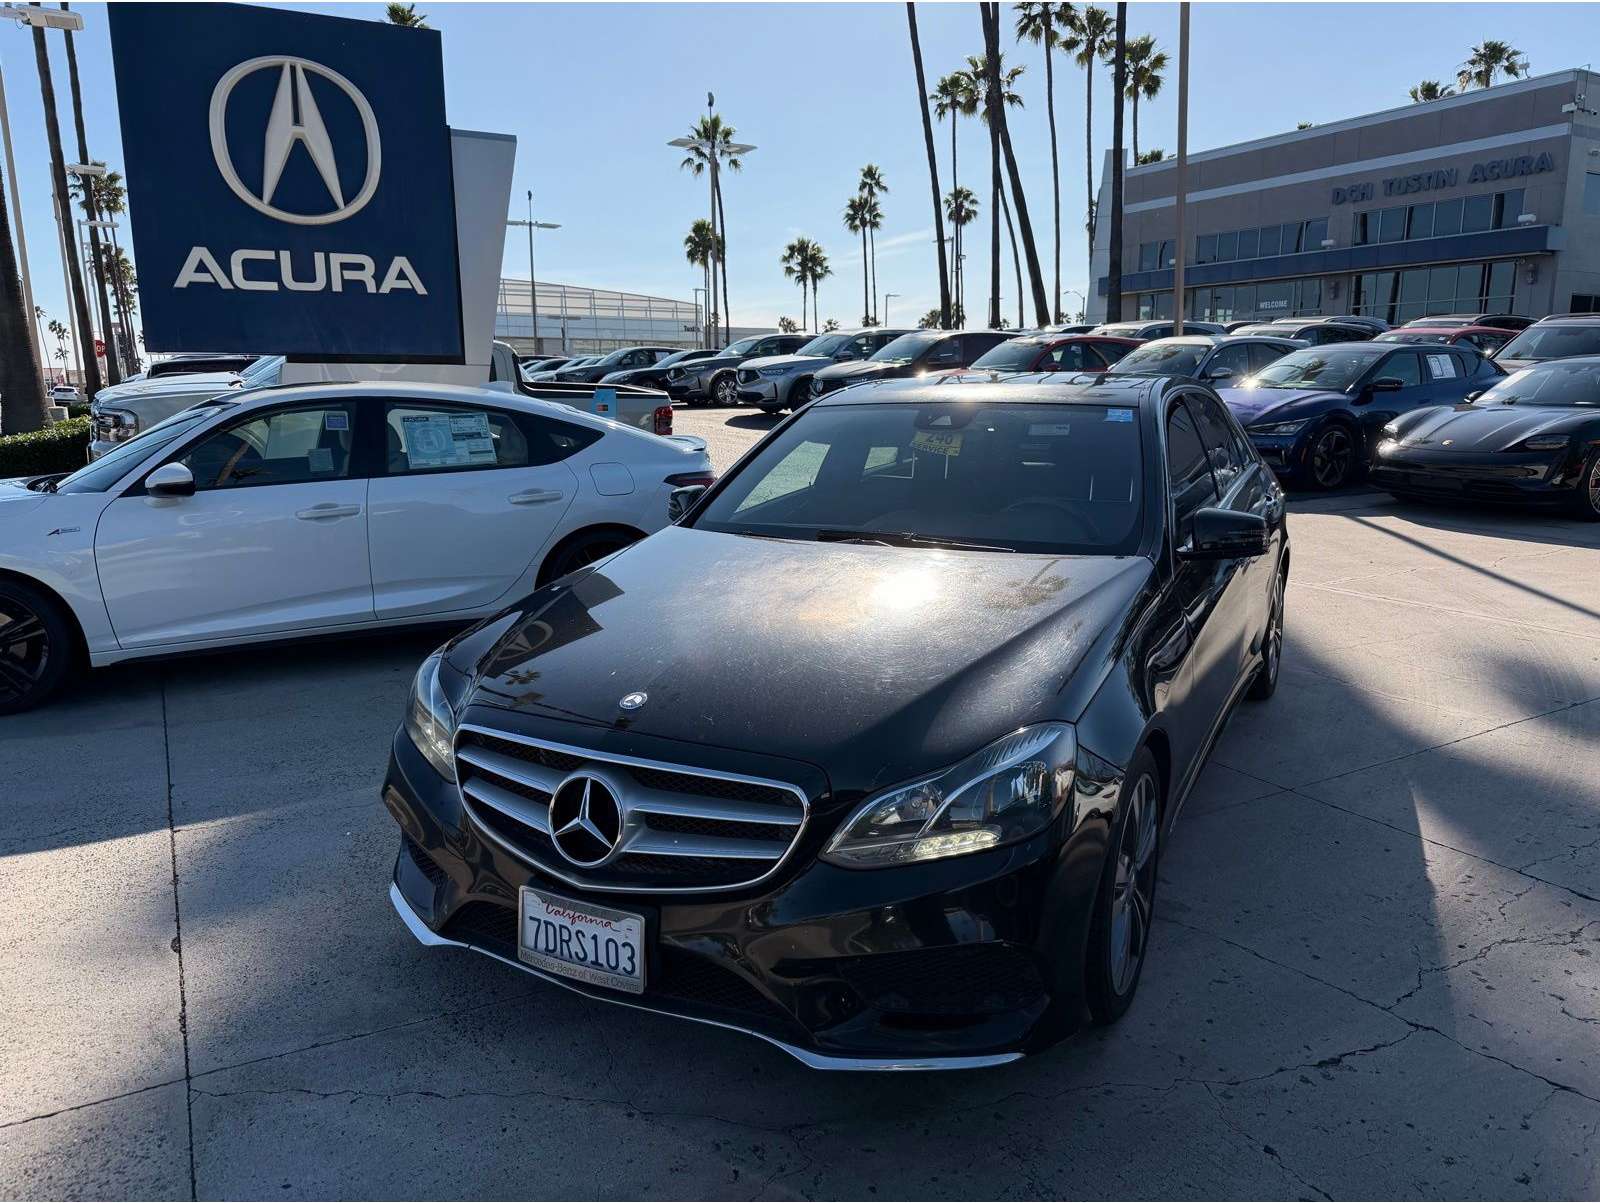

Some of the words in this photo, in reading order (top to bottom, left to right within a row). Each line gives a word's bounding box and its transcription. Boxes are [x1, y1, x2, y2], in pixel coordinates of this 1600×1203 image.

[1332, 182, 1374, 206] DCH
[1382, 168, 1458, 197] TUSTIN
[1467, 151, 1554, 184] ACURA
[174, 246, 428, 296] ACURA
[1258, 299, 1289, 309] WELCOME
[528, 915, 636, 975] 7DRS103
